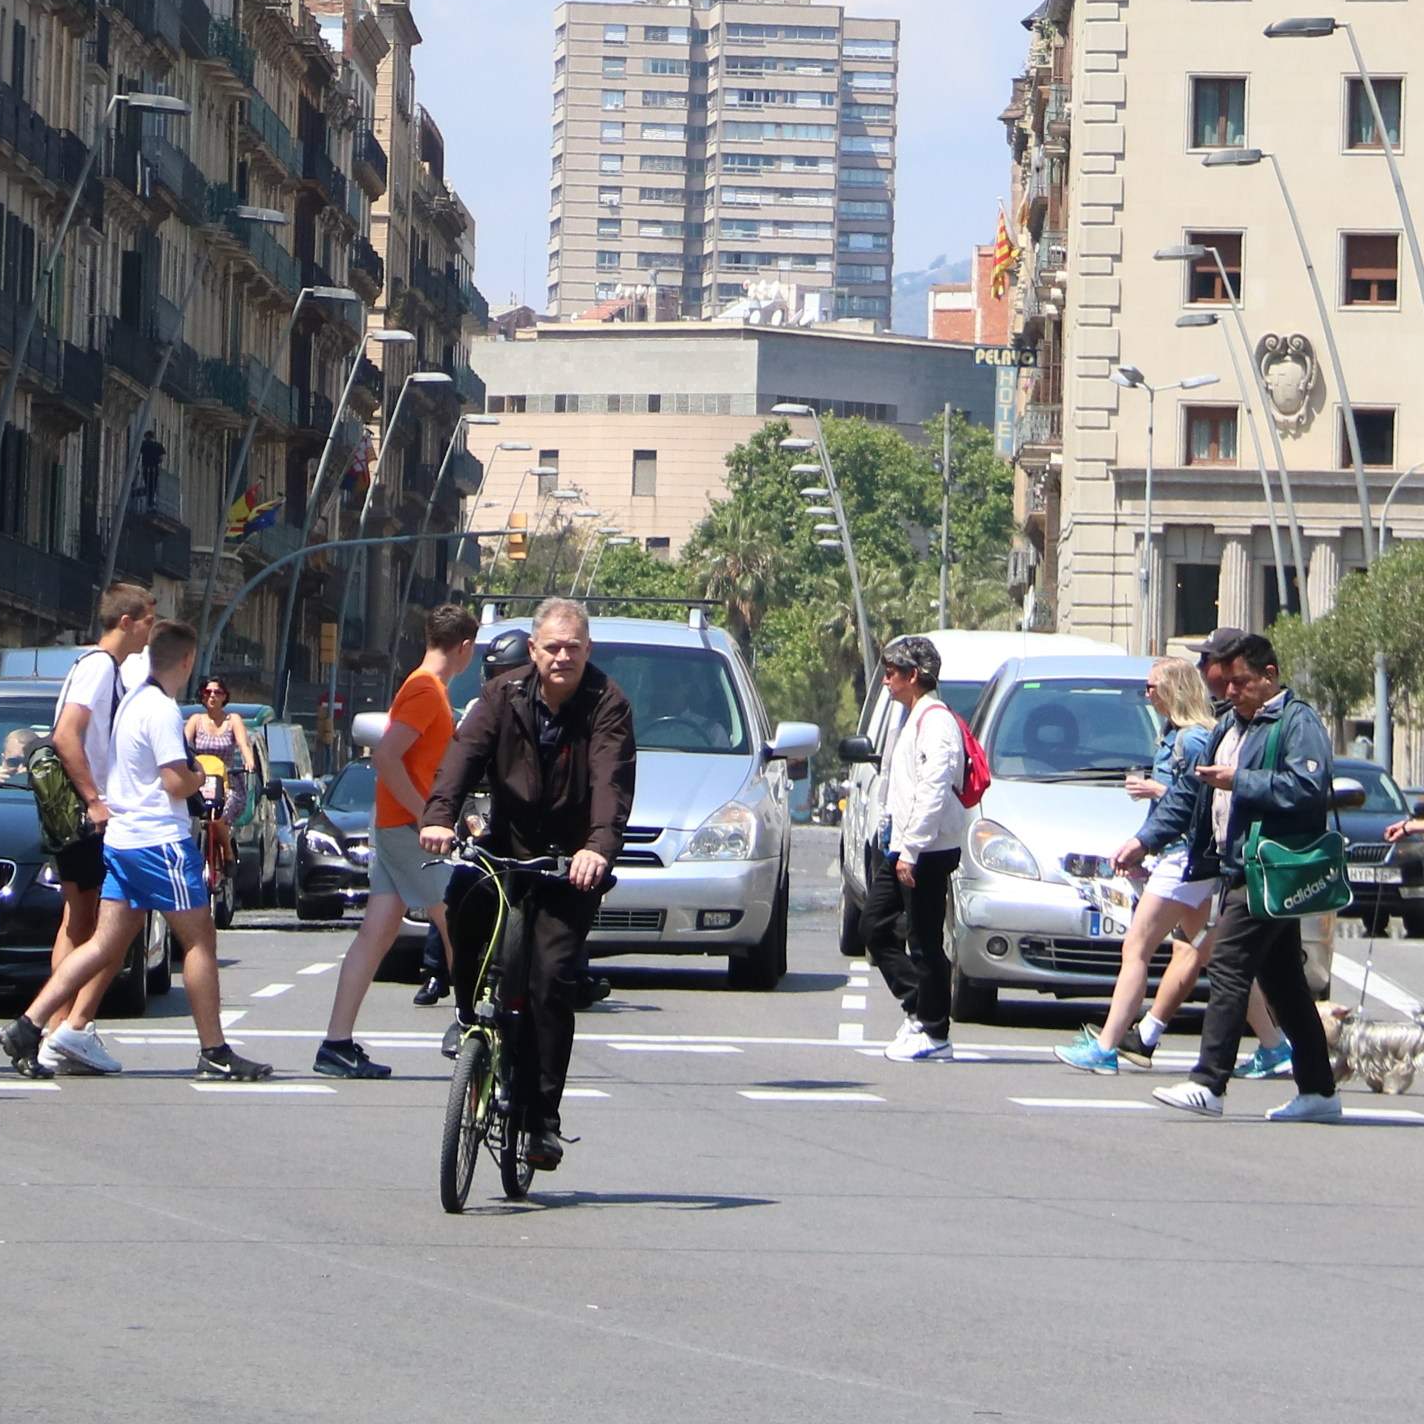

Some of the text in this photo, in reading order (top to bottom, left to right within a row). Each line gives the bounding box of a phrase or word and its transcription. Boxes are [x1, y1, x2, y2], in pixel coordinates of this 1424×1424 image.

[976, 349, 1035, 365] PELAYO
[997, 370, 1015, 451] HOTEL
[1283, 877, 1327, 910] adidas
